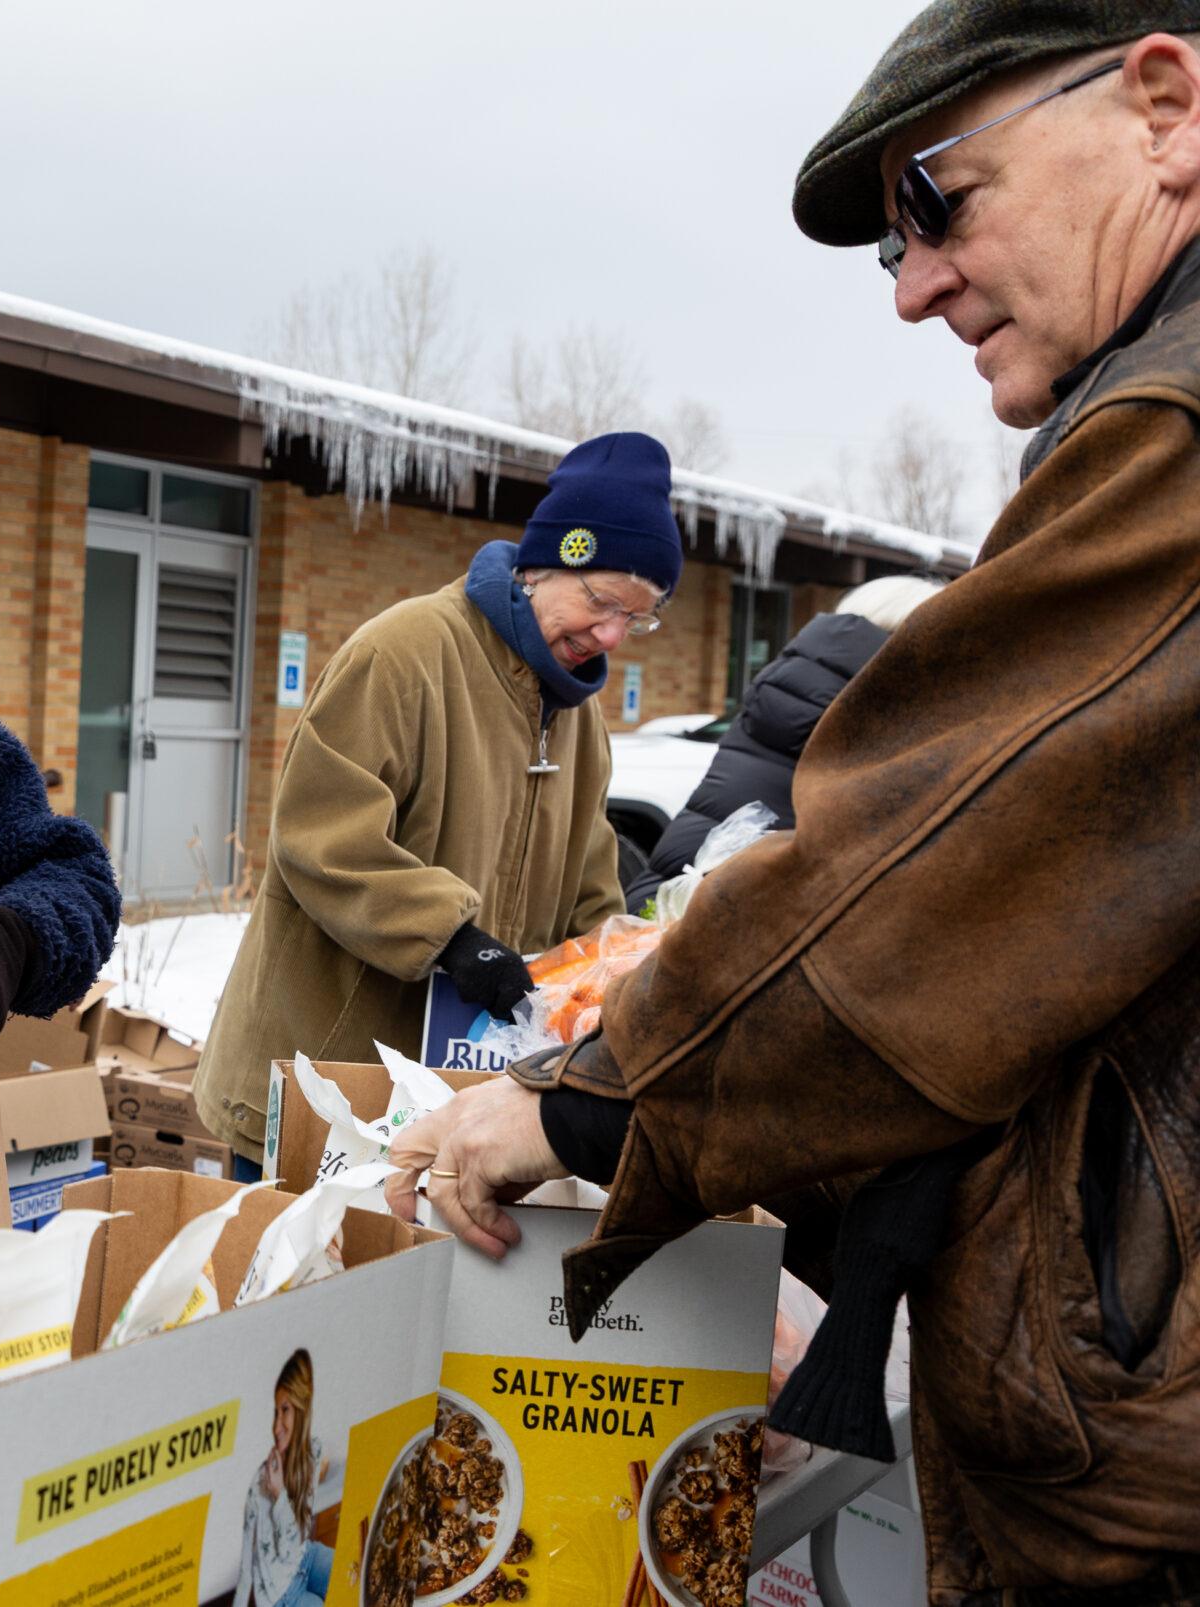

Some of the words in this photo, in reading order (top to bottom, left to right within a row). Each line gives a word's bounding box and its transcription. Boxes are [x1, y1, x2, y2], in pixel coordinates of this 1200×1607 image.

[449, 1042, 512, 1072] BLU
[492, 1367, 685, 1406] SALTY-SWEET
[522, 1403, 655, 1438] GRANOLA
[37, 1474, 77, 1522] THE
[85, 1441, 161, 1503] PURELY
[166, 1415, 227, 1469] STORY
[760, 1578, 807, 1607] FARMS
